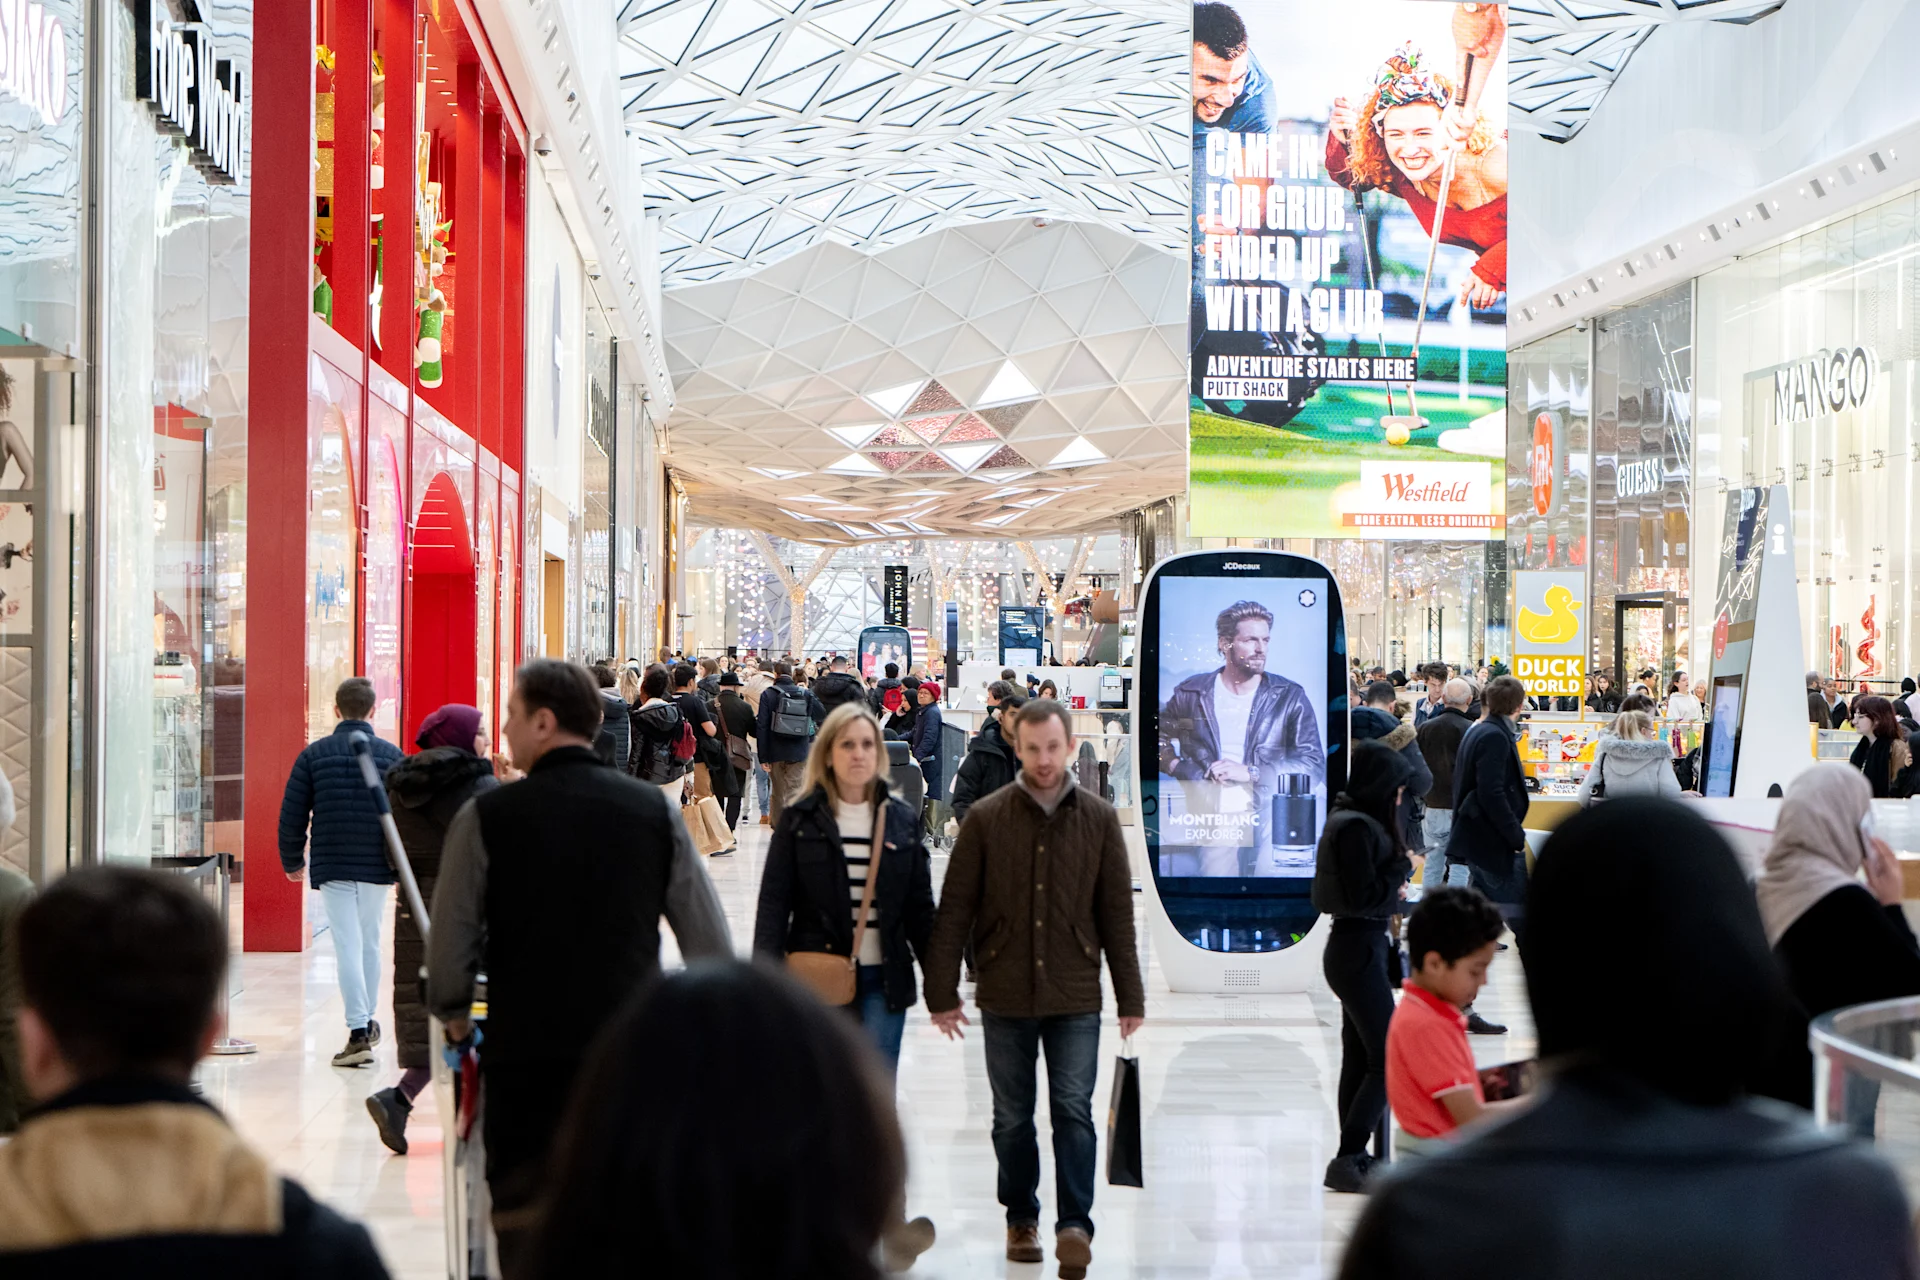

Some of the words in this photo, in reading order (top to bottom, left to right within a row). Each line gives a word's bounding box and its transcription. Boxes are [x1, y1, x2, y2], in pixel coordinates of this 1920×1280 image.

[197, 29, 245, 186] World
[1206, 131, 1283, 178] CAME
[1289, 134, 1318, 179] IN
[1206, 183, 1260, 230] FOR
[1266, 185, 1353, 231] GRUB.
[1205, 234, 1295, 281] ENDED
[1301, 237, 1340, 282] UP
[1205, 286, 1280, 332] WITH
[1285, 287, 1304, 332] A
[1310, 288, 1384, 333] CLUB
[1207, 355, 1304, 378] ADVENTURE
[1307, 358, 1369, 379] STARTS
[1373, 359, 1414, 380] HERE
[1207, 381, 1240, 397] PUTT
[1244, 382, 1284, 397] SHACK
[1774, 346, 1870, 425] MANGO
[1381, 473, 1471, 502] Westfield
[1617, 457, 1659, 497] GUESS
[1355, 514, 1381, 526] MORE
[1384, 515, 1418, 527] EXTRA,
[1422, 515, 1445, 527] LESS
[1449, 515, 1497, 527] ORDINARY
[1222, 562, 1261, 571] JCDecaux
[894, 570, 902, 597] JOHN
[894, 600, 902, 626] LEWI
[1517, 658, 1581, 677] DUCK
[1521, 679, 1580, 693] WORLD
[1169, 813, 1260, 827] MONTBLANC
[1185, 829, 1244, 840] EXPLORER
